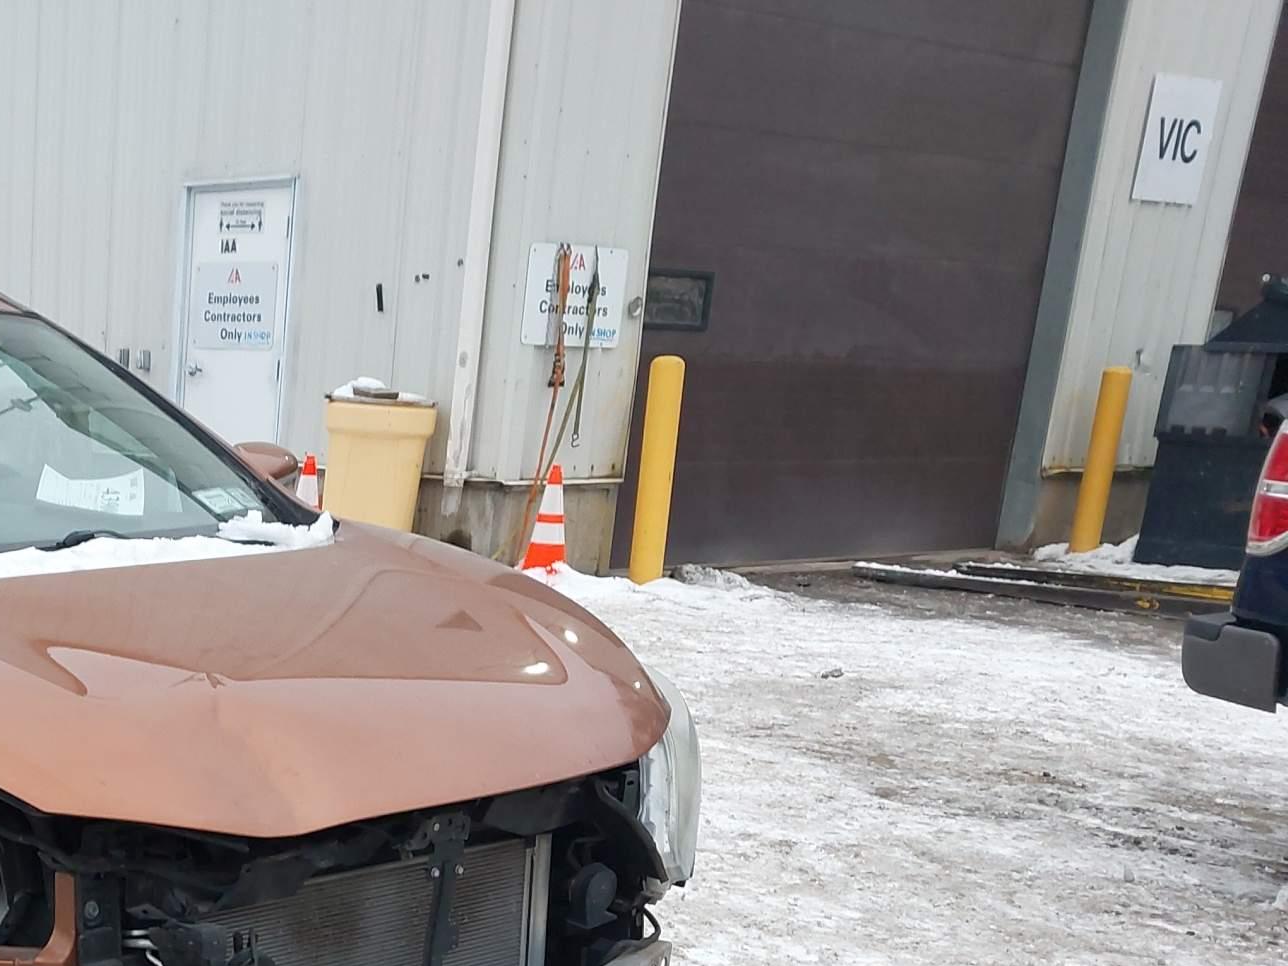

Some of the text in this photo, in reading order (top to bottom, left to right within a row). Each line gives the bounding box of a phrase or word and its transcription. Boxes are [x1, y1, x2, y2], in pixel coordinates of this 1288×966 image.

[1159, 117, 1201, 163] VIC
[220, 239, 237, 254] IAA
[208, 292, 260, 307] Employees
[204, 310, 262, 323] Contractors
[220, 328, 242, 343] Only
